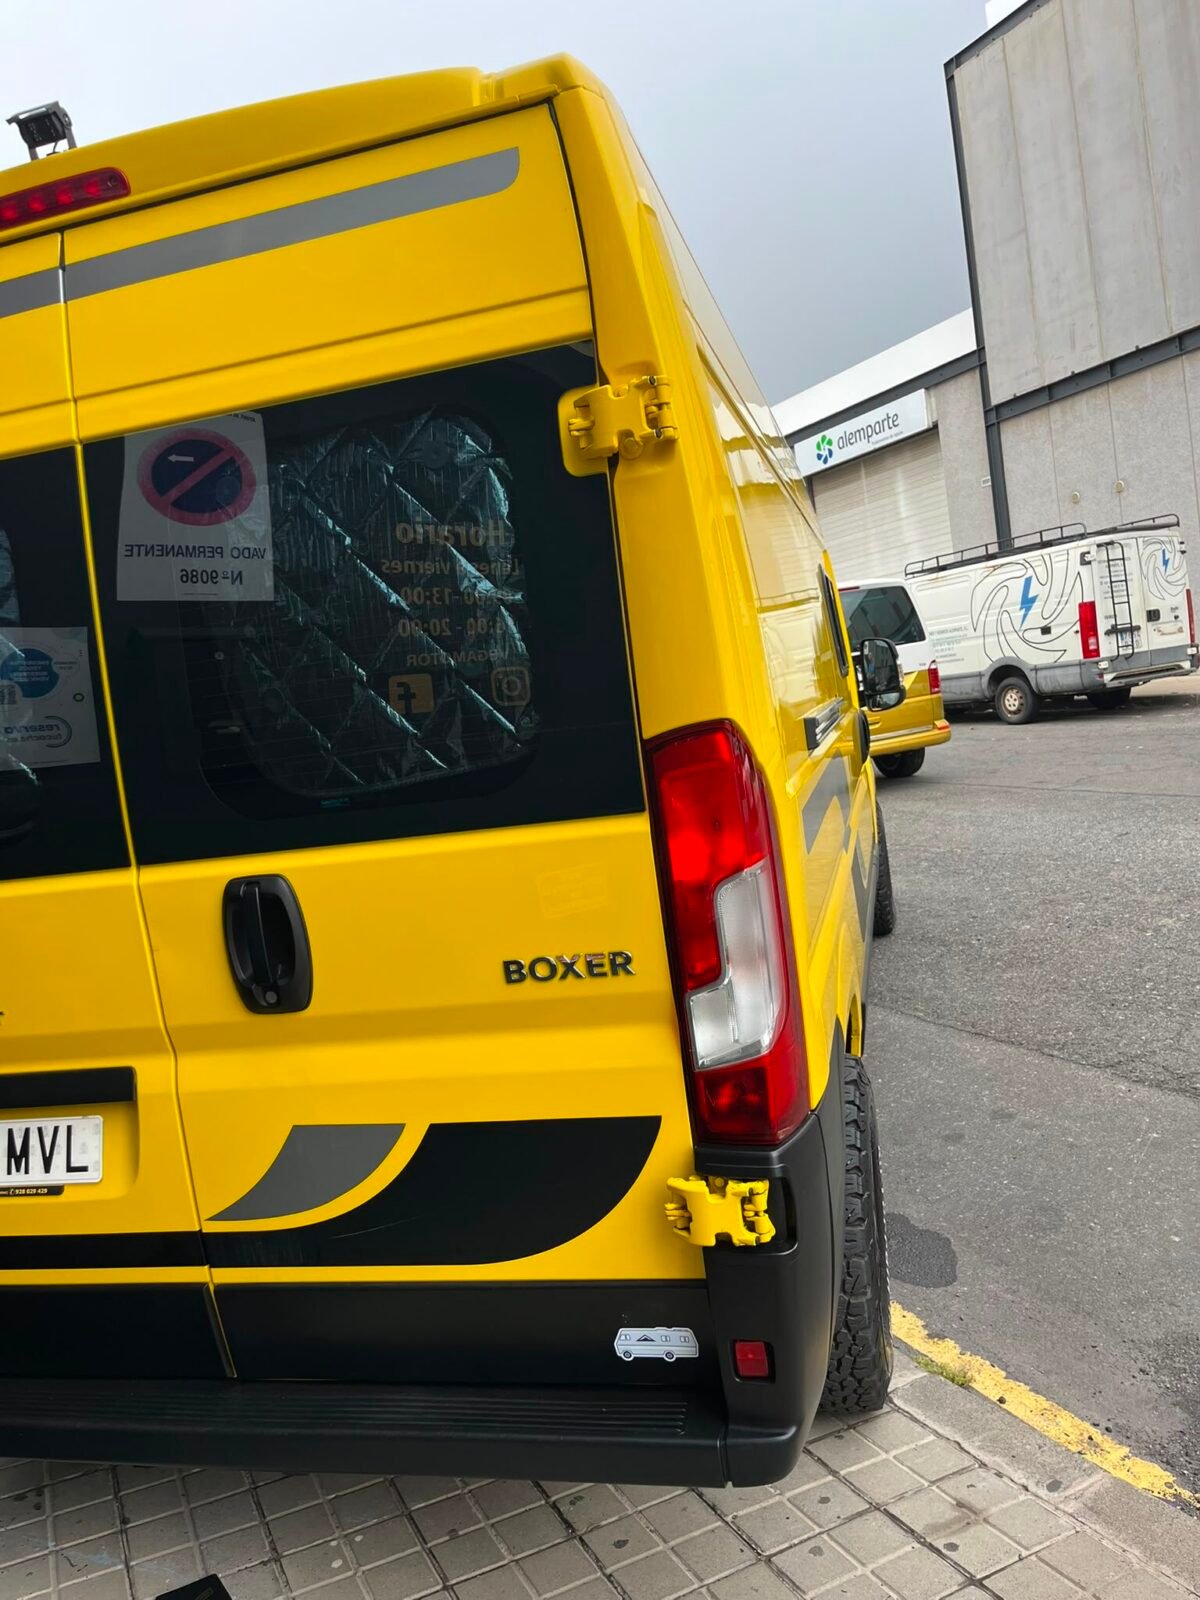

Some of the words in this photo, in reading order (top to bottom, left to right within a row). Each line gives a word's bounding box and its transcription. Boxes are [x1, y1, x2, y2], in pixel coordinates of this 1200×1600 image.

[837, 412, 900, 450] alemparte
[503, 950, 636, 984] BOXER
[6, 1124, 89, 1176] MVL
